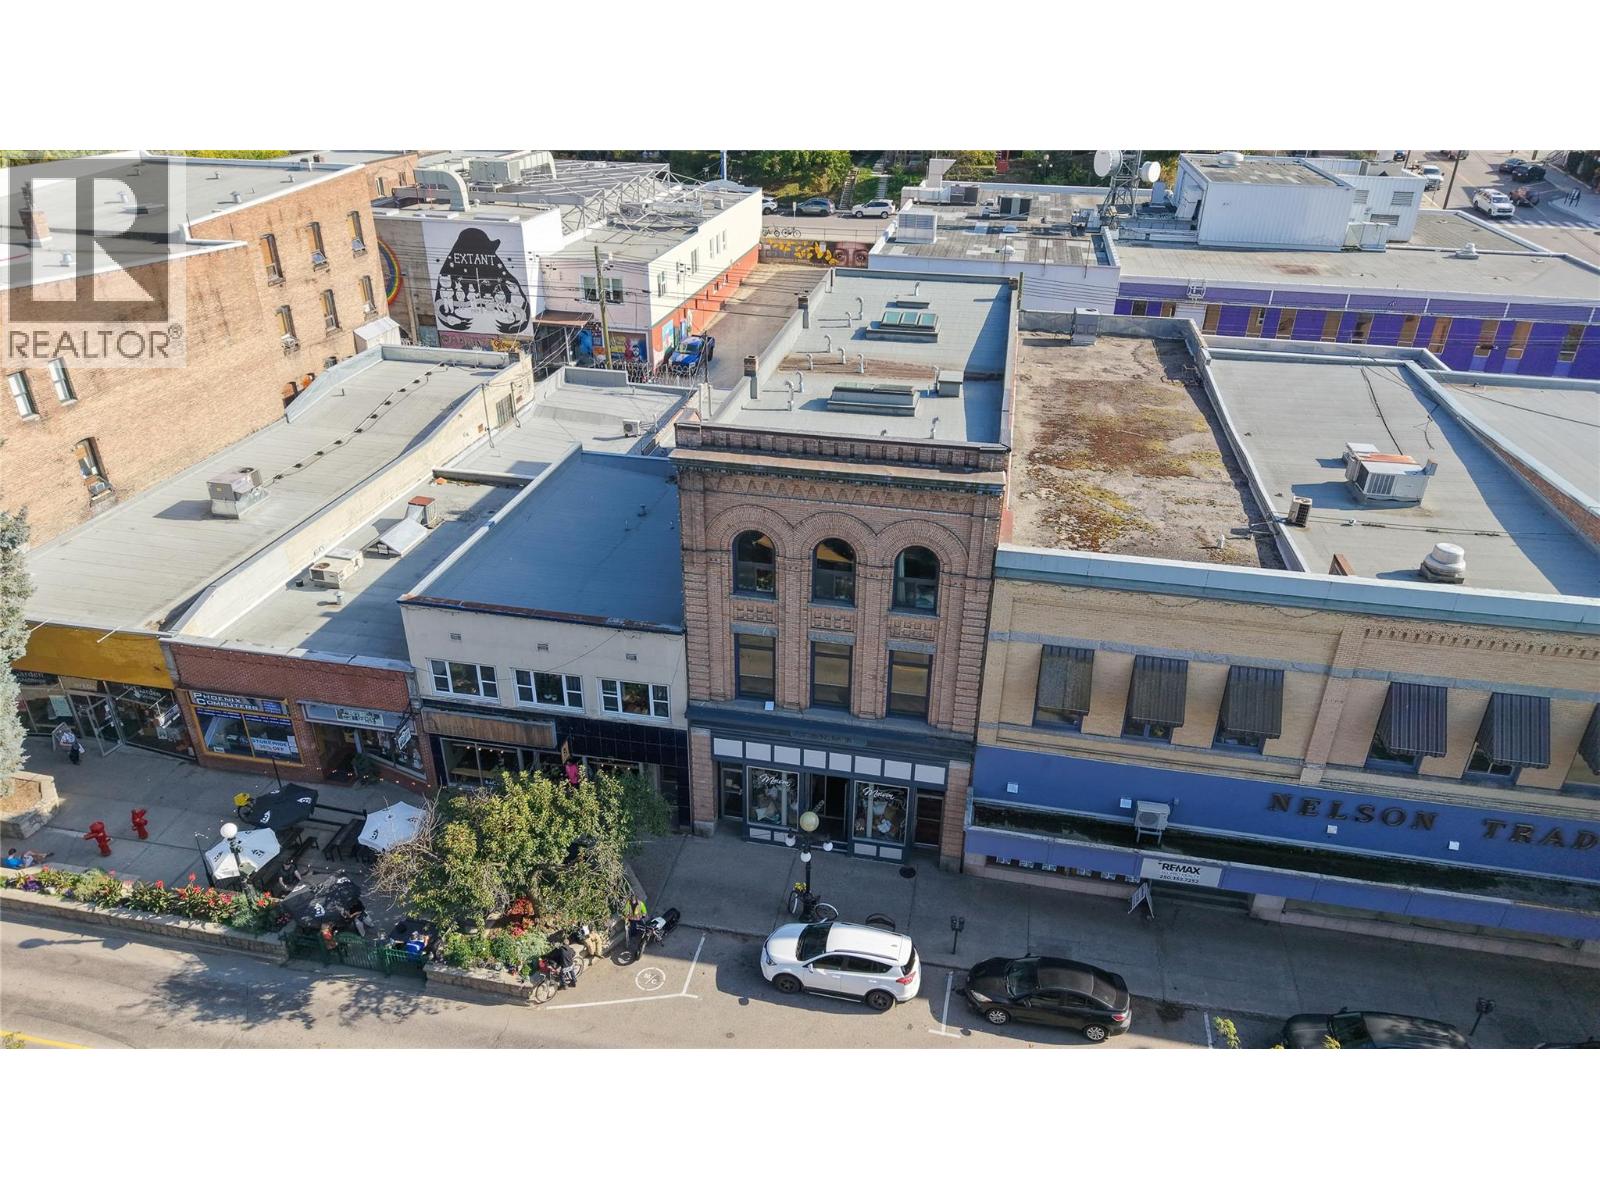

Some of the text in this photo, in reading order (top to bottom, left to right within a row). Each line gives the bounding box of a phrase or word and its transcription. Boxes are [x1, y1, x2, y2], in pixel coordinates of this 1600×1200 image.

[453, 252, 496, 266] EXTANT
[1266, 792, 1599, 851] NELSON TRAD
